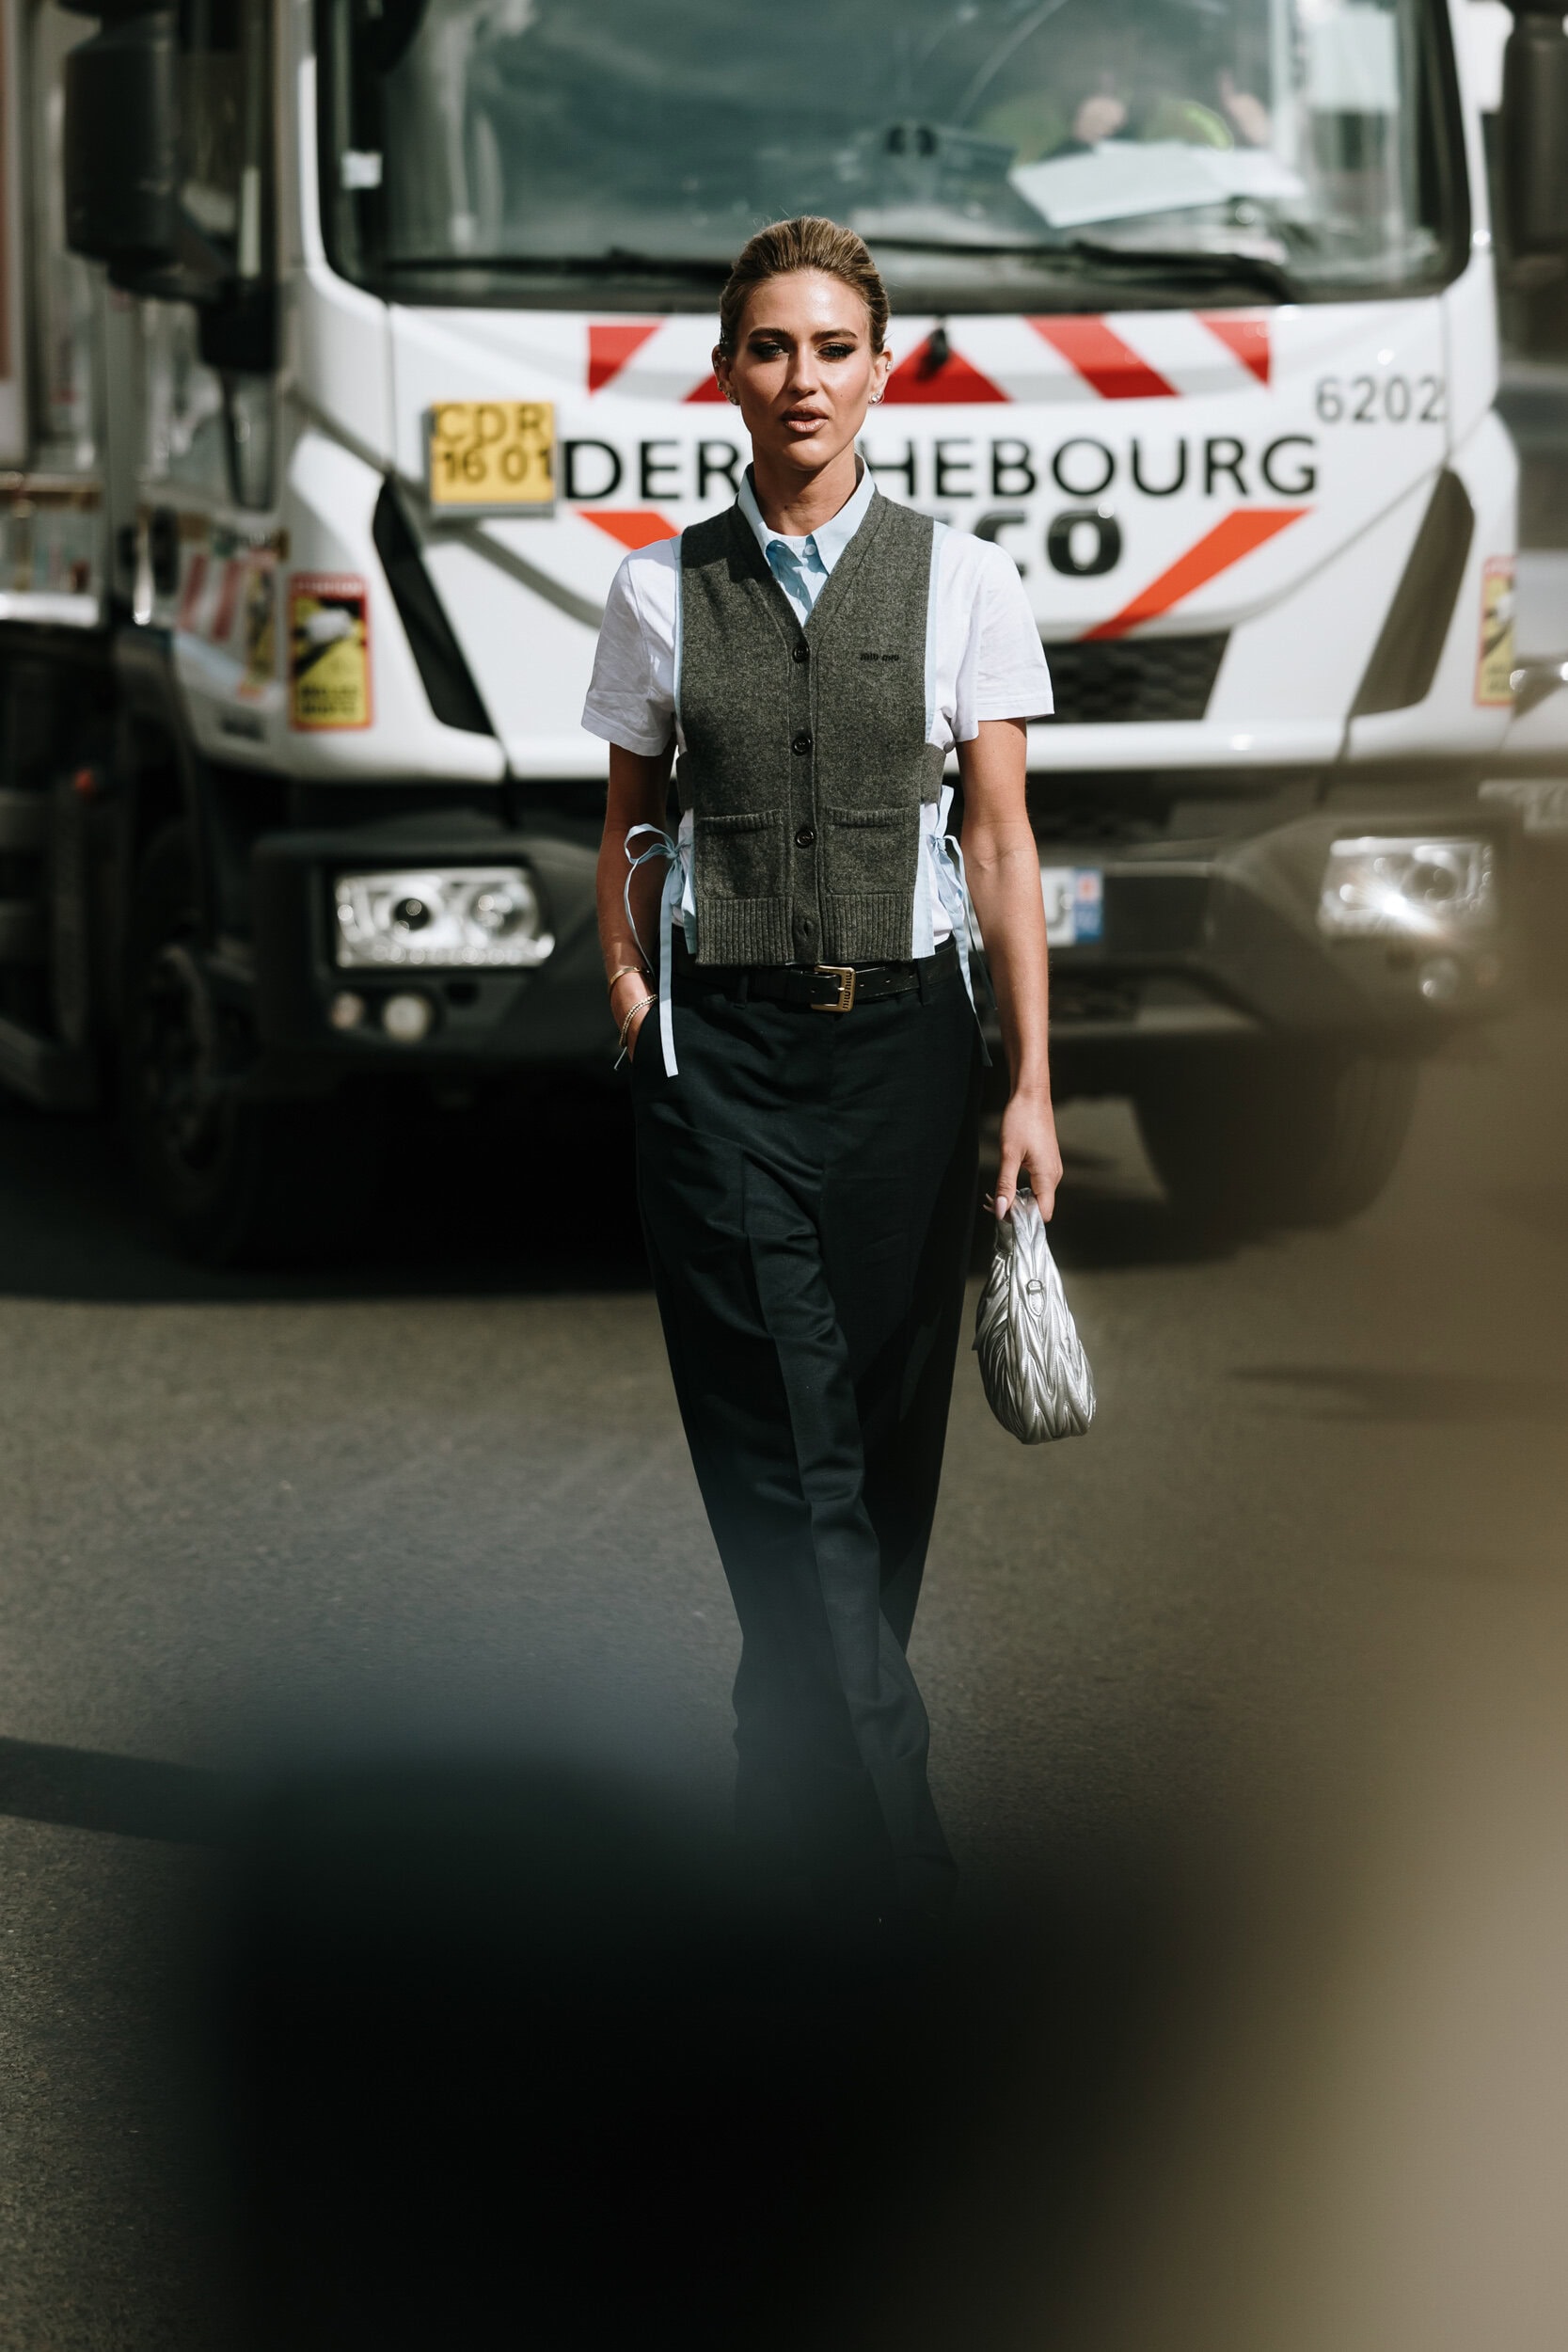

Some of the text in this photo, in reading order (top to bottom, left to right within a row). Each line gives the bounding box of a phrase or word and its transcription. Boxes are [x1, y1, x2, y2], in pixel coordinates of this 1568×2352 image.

[1315, 374, 1446, 423] 6202
[436, 403, 546, 447] CDR
[562, 437, 1316, 500] DERHEBOURG
